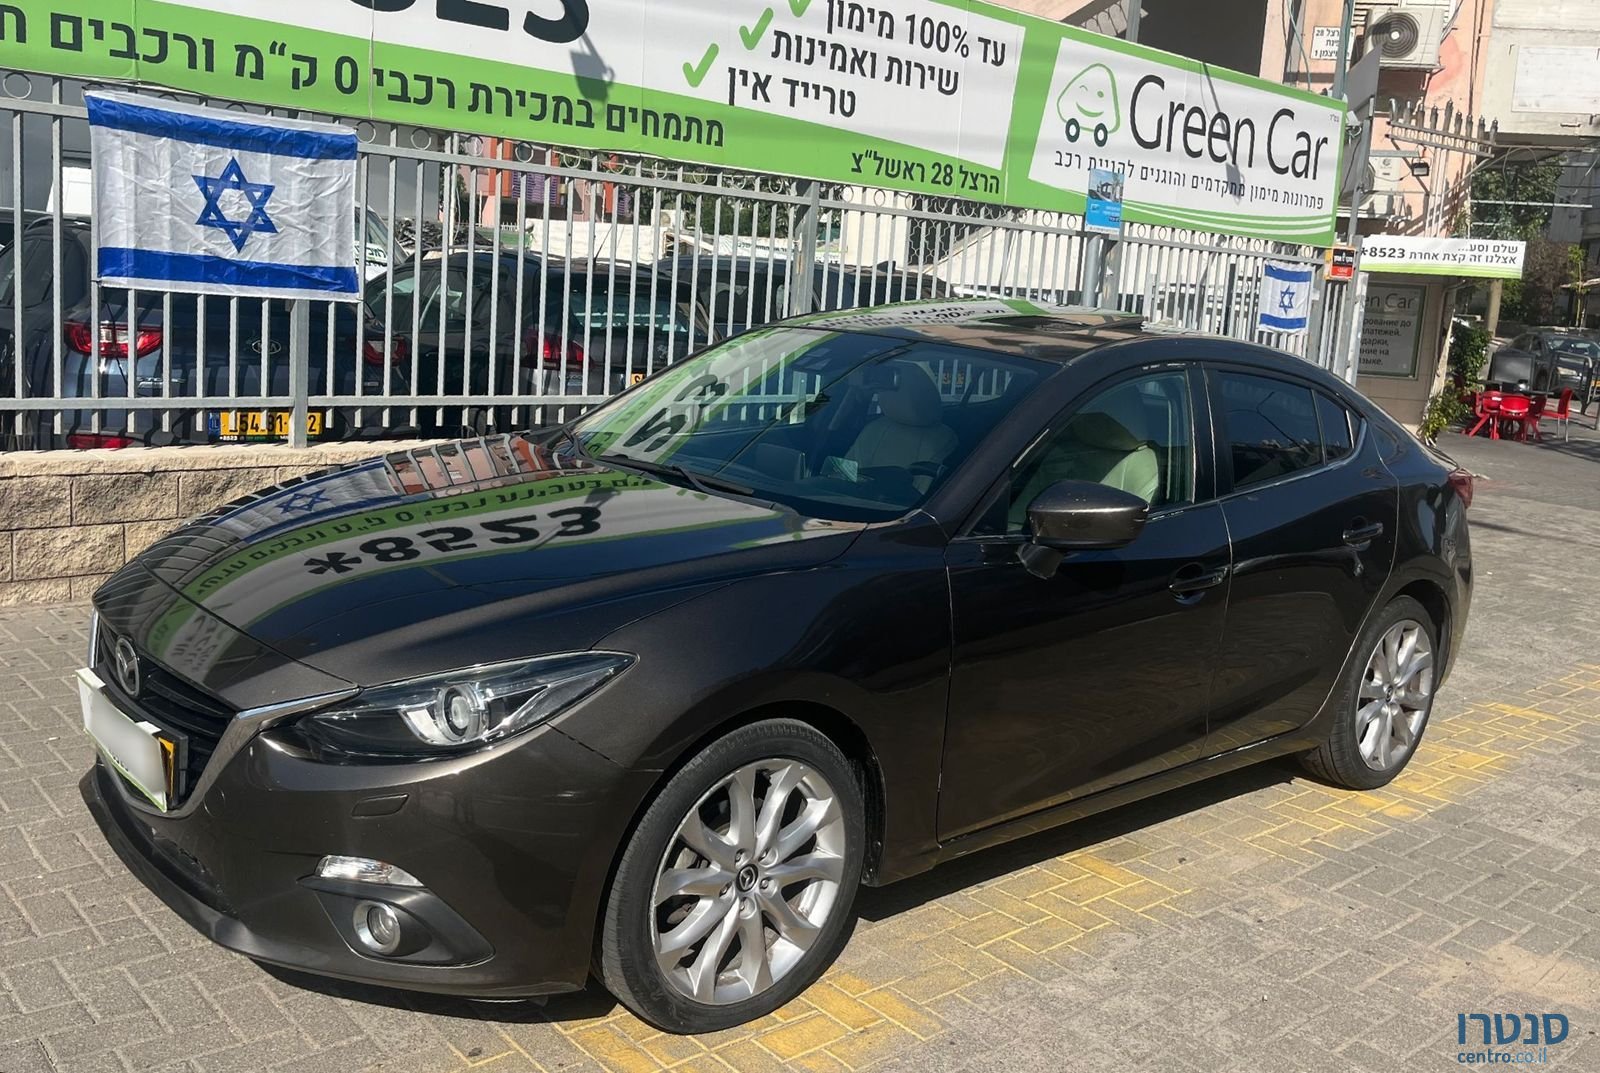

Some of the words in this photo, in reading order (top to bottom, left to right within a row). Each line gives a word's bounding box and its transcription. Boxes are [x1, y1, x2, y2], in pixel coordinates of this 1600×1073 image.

[828, 0, 895, 40] מימון
[51, 13, 215, 73] ורכבים
[906, 14, 969, 58] 100%
[772, 30, 877, 79] ואמינות
[978, 37, 1006, 67] עד
[335, 56, 359, 95] 0
[373, 68, 456, 110] רכבי
[729, 67, 772, 107] אין
[885, 56, 959, 96] שירות
[468, 83, 595, 129] במכירת
[783, 78, 856, 118] טרייד
[607, 104, 724, 147] מתמחים
[1130, 75, 1256, 168] Green
[1267, 109, 1329, 181] Car
[931, 162, 954, 187] 28
[1055, 150, 1082, 170] רכב
[960, 165, 1000, 194] הרצל
[1140, 166, 1186, 188] והוגנים
[1191, 175, 1246, 199] מתקדמים
[1250, 185, 1279, 203] מימון
[1282, 190, 1324, 210] פתרונות
[1409, 251, 1440, 261] אחרת
[1442, 253, 1466, 264] קצת
[1470, 254, 1482, 262] זה
[1485, 253, 1517, 264] אצלנו
[1493, 244, 1518, 254] שלם
[1385, 293, 1415, 309] Car
